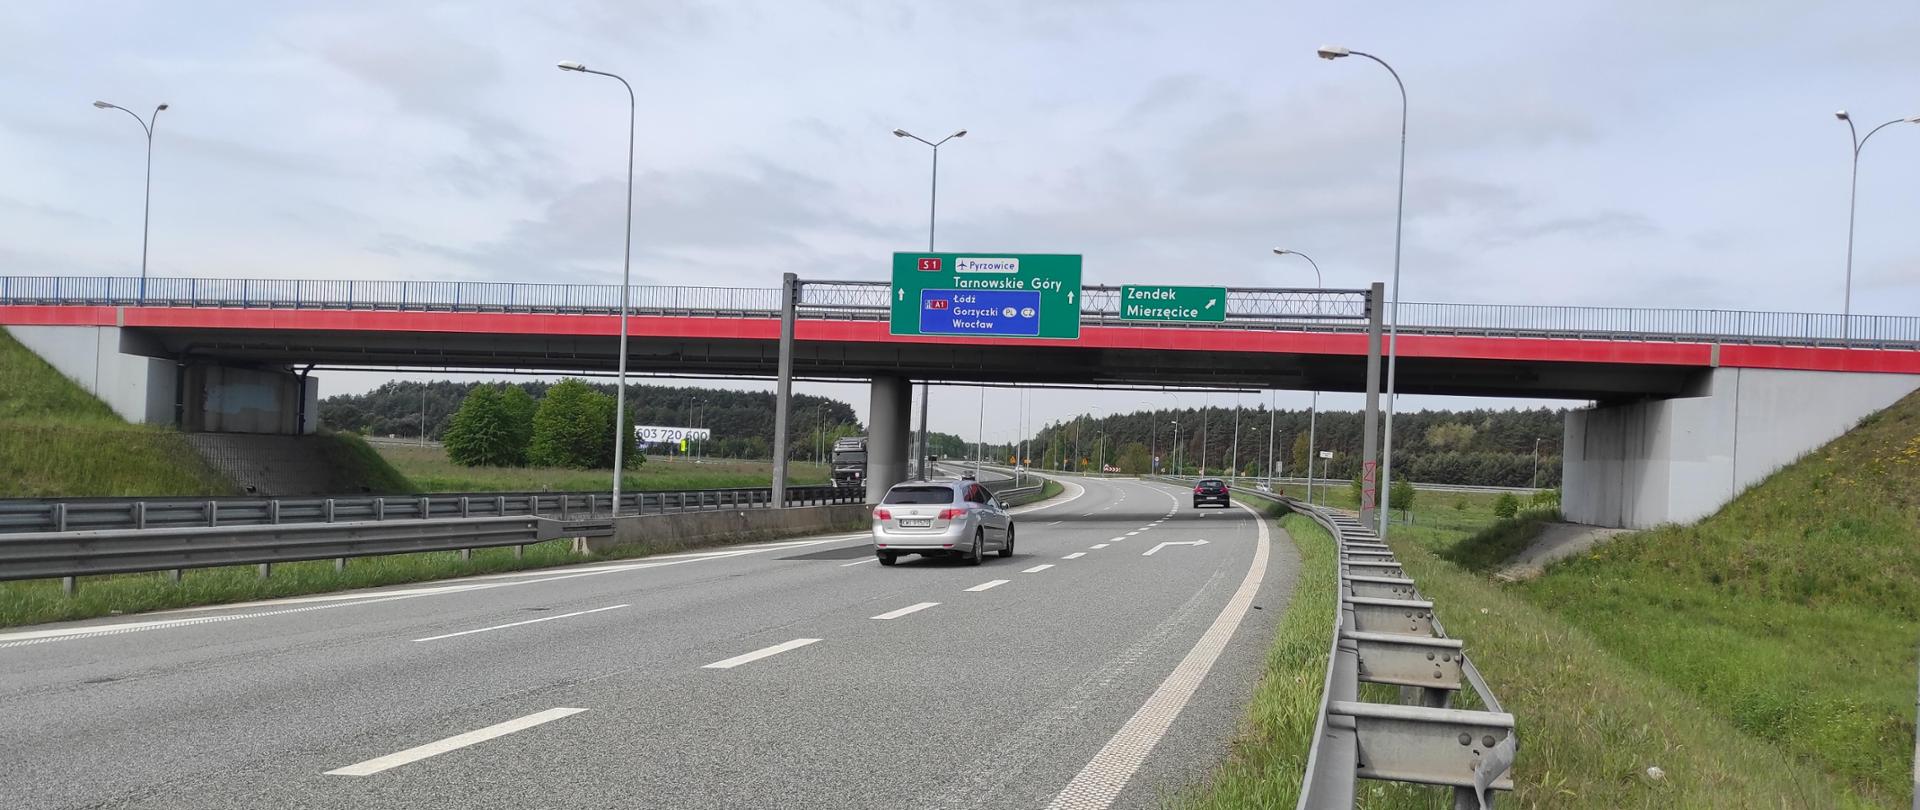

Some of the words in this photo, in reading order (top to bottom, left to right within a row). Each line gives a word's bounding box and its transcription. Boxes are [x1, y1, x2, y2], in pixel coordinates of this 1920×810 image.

[969, 261, 1015, 271] Pyrzowice
[953, 276, 1024, 289] Tarnowskie
[1031, 277, 1062, 292] Góry
[953, 294, 976, 303] Łódź
[1128, 288, 1176, 300] Zendek
[935, 300, 944, 308] A1
[953, 307, 998, 317] Gorzyczki
[1022, 309, 1033, 317] CZ
[1127, 304, 1198, 320] Mierzęcice
[952, 319, 993, 329] Wrocław
[661, 429, 682, 440] 720
[686, 431, 708, 441] 600
